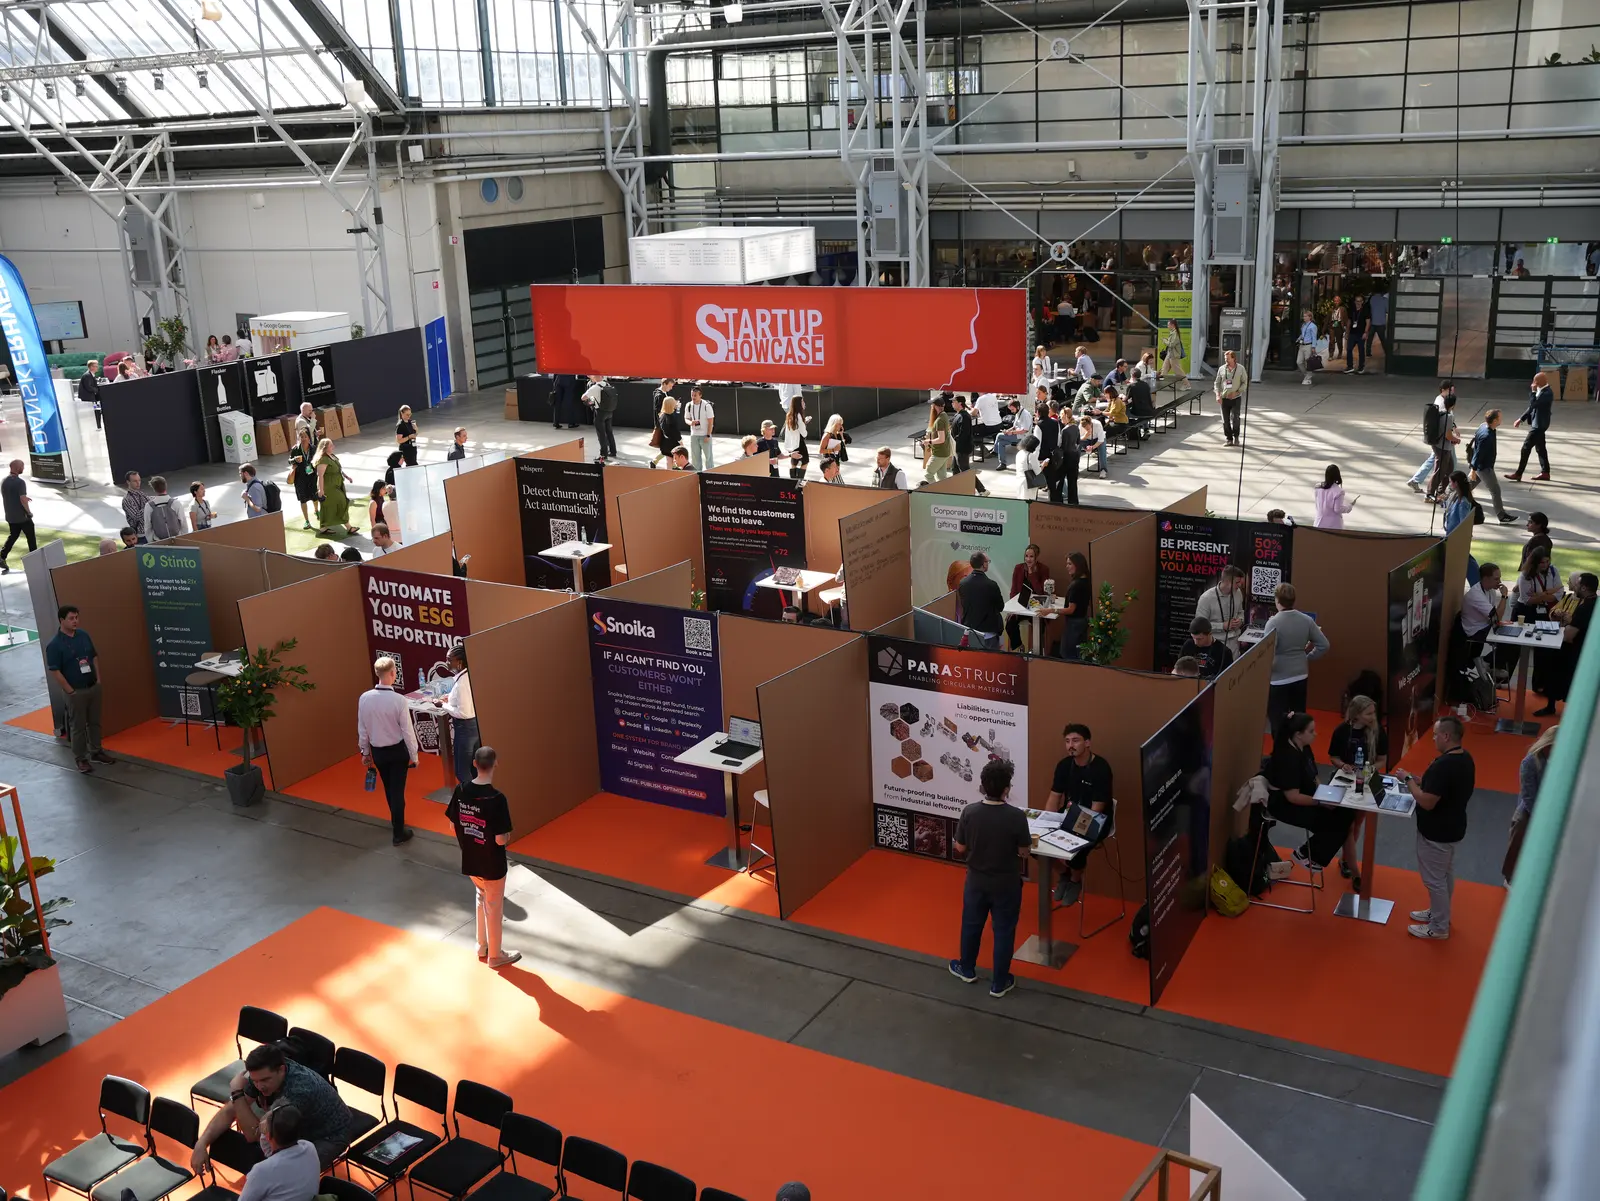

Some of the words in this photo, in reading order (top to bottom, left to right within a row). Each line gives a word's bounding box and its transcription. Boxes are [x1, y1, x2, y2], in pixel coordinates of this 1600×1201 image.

[695, 303, 823, 358] STARTUP
[522, 484, 550, 497] Detect
[552, 487, 578, 500] churn
[579, 490, 600, 504] early.
[780, 492, 796, 500] 5.1x
[525, 498, 540, 510] Act
[542, 502, 600, 518] automatically.
[708, 504, 721, 513] We
[722, 506, 737, 515] find
[738, 508, 751, 516] the
[753, 510, 795, 520] customers
[934, 507, 968, 518] Corporate
[974, 511, 994, 520] giving
[708, 515, 731, 523] about
[741, 517, 764, 526] leave.
[937, 520, 958, 530] gifting
[962, 523, 1001, 534] reimagined
[1160, 538, 1175, 548] BE
[1177, 539, 1231, 555] PRESENT.
[1255, 538, 1282, 551] 50%
[160, 555, 196, 568] Stinto
[1160, 550, 1190, 560] EVEN
[1192, 552, 1228, 565] WHEN
[1255, 550, 1278, 560] OFF
[1160, 561, 1184, 572] YOU
[368, 576, 452, 605] AUTOMATE
[369, 598, 414, 621] YOUR
[418, 605, 454, 627] ESG
[606, 616, 656, 638] Snoika
[603, 650, 612, 659] IF
[614, 653, 624, 662] AI
[626, 654, 654, 666] CAN'T
[656, 660, 680, 670] FIND
[682, 663, 706, 676] YOU,
[608, 664, 667, 680] CUSTOMERS
[668, 673, 702, 687] WON'T
[907, 659, 1018, 686] PARASTRUCT
[638, 682, 673, 694] EITHER
[908, 674, 941, 685] ENABLING
[943, 679, 976, 690] CIRCULAR
[978, 685, 1015, 696] MATERIALS
[636, 696, 661, 704] companies
[671, 700, 686, 709] found,
[957, 703, 990, 714] Liabilities
[991, 708, 1014, 717] turned
[622, 710, 642, 718] ChatGPT
[678, 720, 702, 730] Perplexity
[968, 715, 1016, 727] opportunities
[626, 734, 647, 744] SYSTEM
[661, 740, 681, 750] BRAND
[612, 744, 627, 752] Brand
[633, 748, 656, 758] Website
[634, 761, 654, 770] Signals
[660, 767, 697, 778] Communities
[620, 776, 640, 785] CREATE.
[640, 781, 662, 790] PUBLISH.
[662, 785, 687, 795] OPTIMIZE.
[884, 784, 936, 800] Future-proofing
[936, 793, 968, 805] buildings
[900, 795, 931, 806] industrial
[932, 802, 961, 812] leftovers
